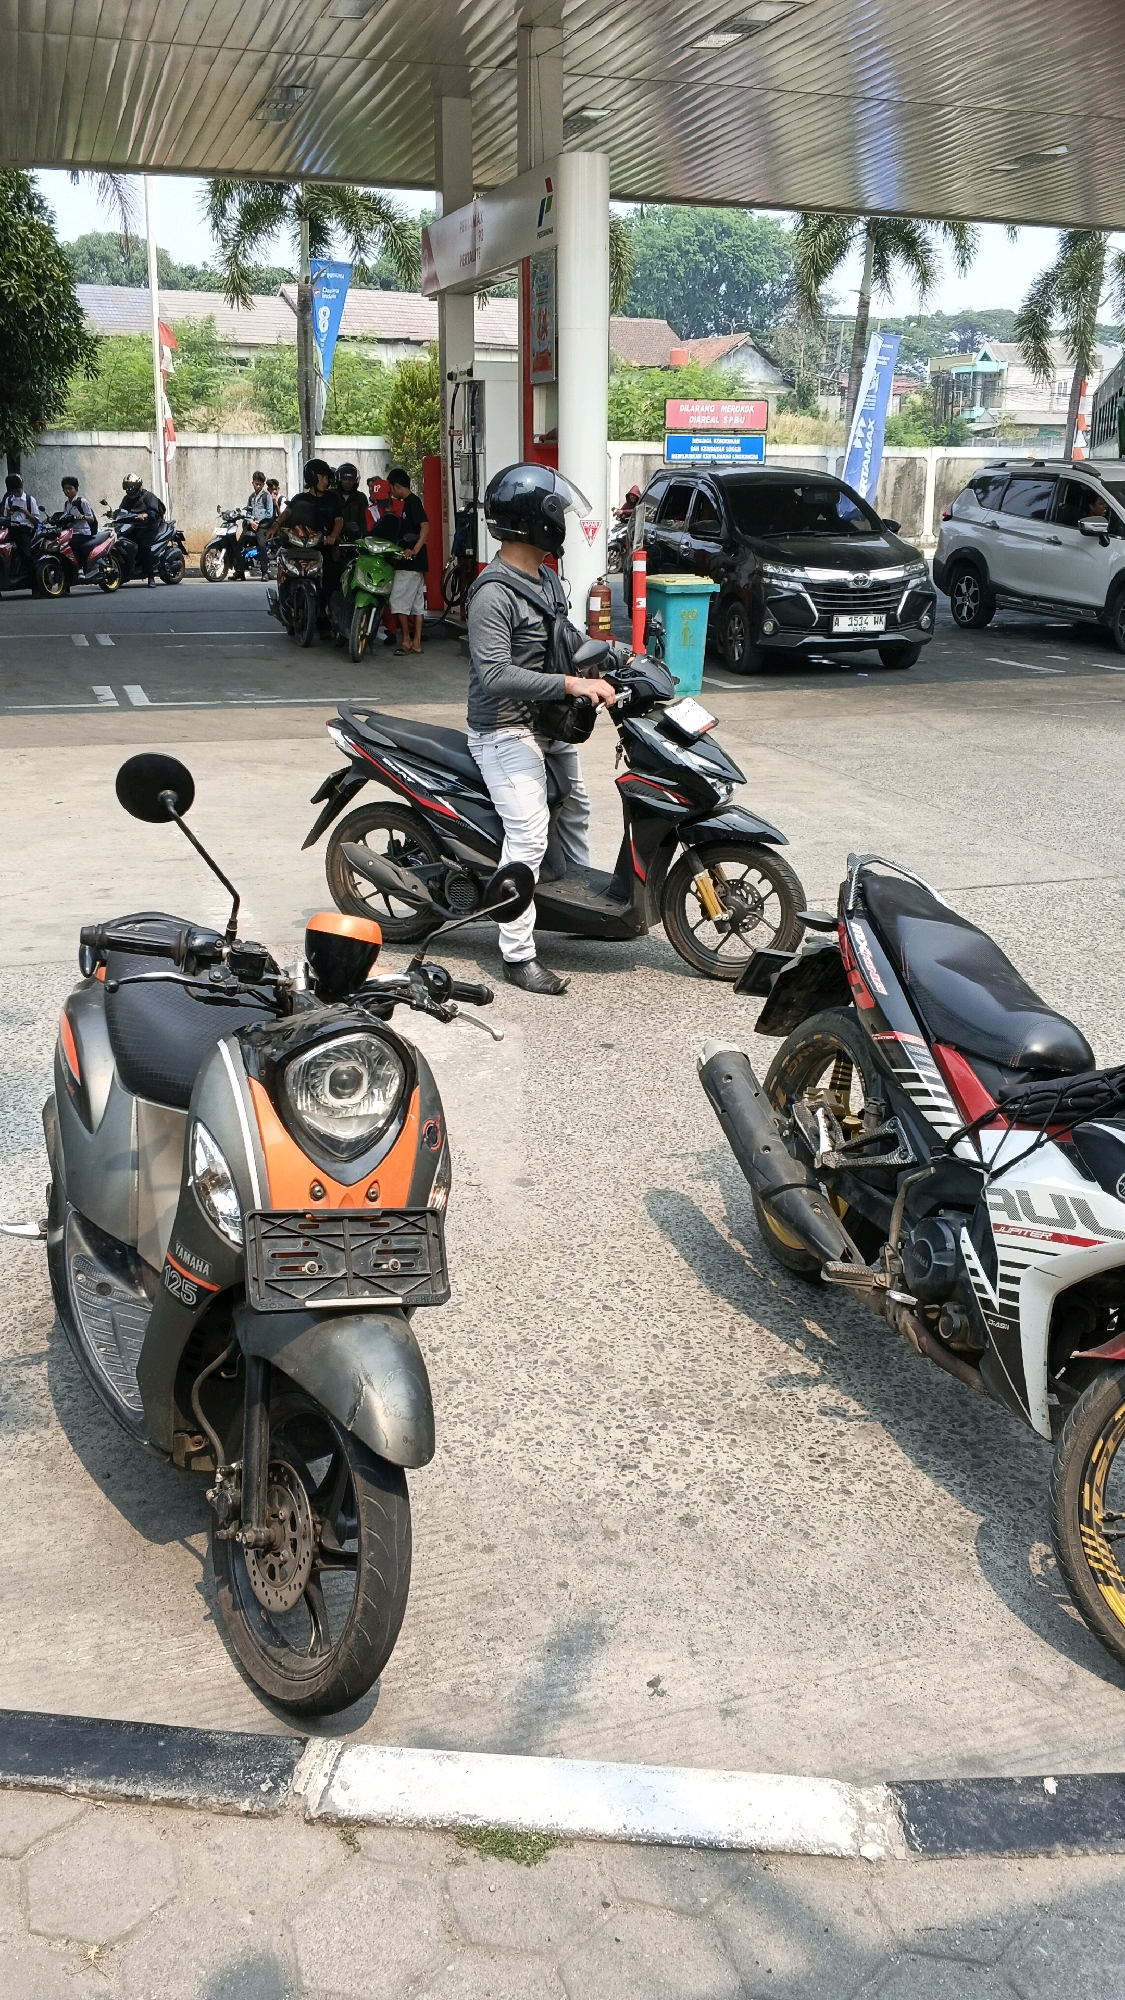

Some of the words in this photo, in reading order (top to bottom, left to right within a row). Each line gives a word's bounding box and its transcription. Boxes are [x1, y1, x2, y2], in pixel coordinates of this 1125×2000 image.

[834, 617, 839, 626] A
[994, 1226, 1053, 1240] JUPITER
[175, 1242, 209, 1276] YAMAHA
[164, 1264, 198, 1305] 125
